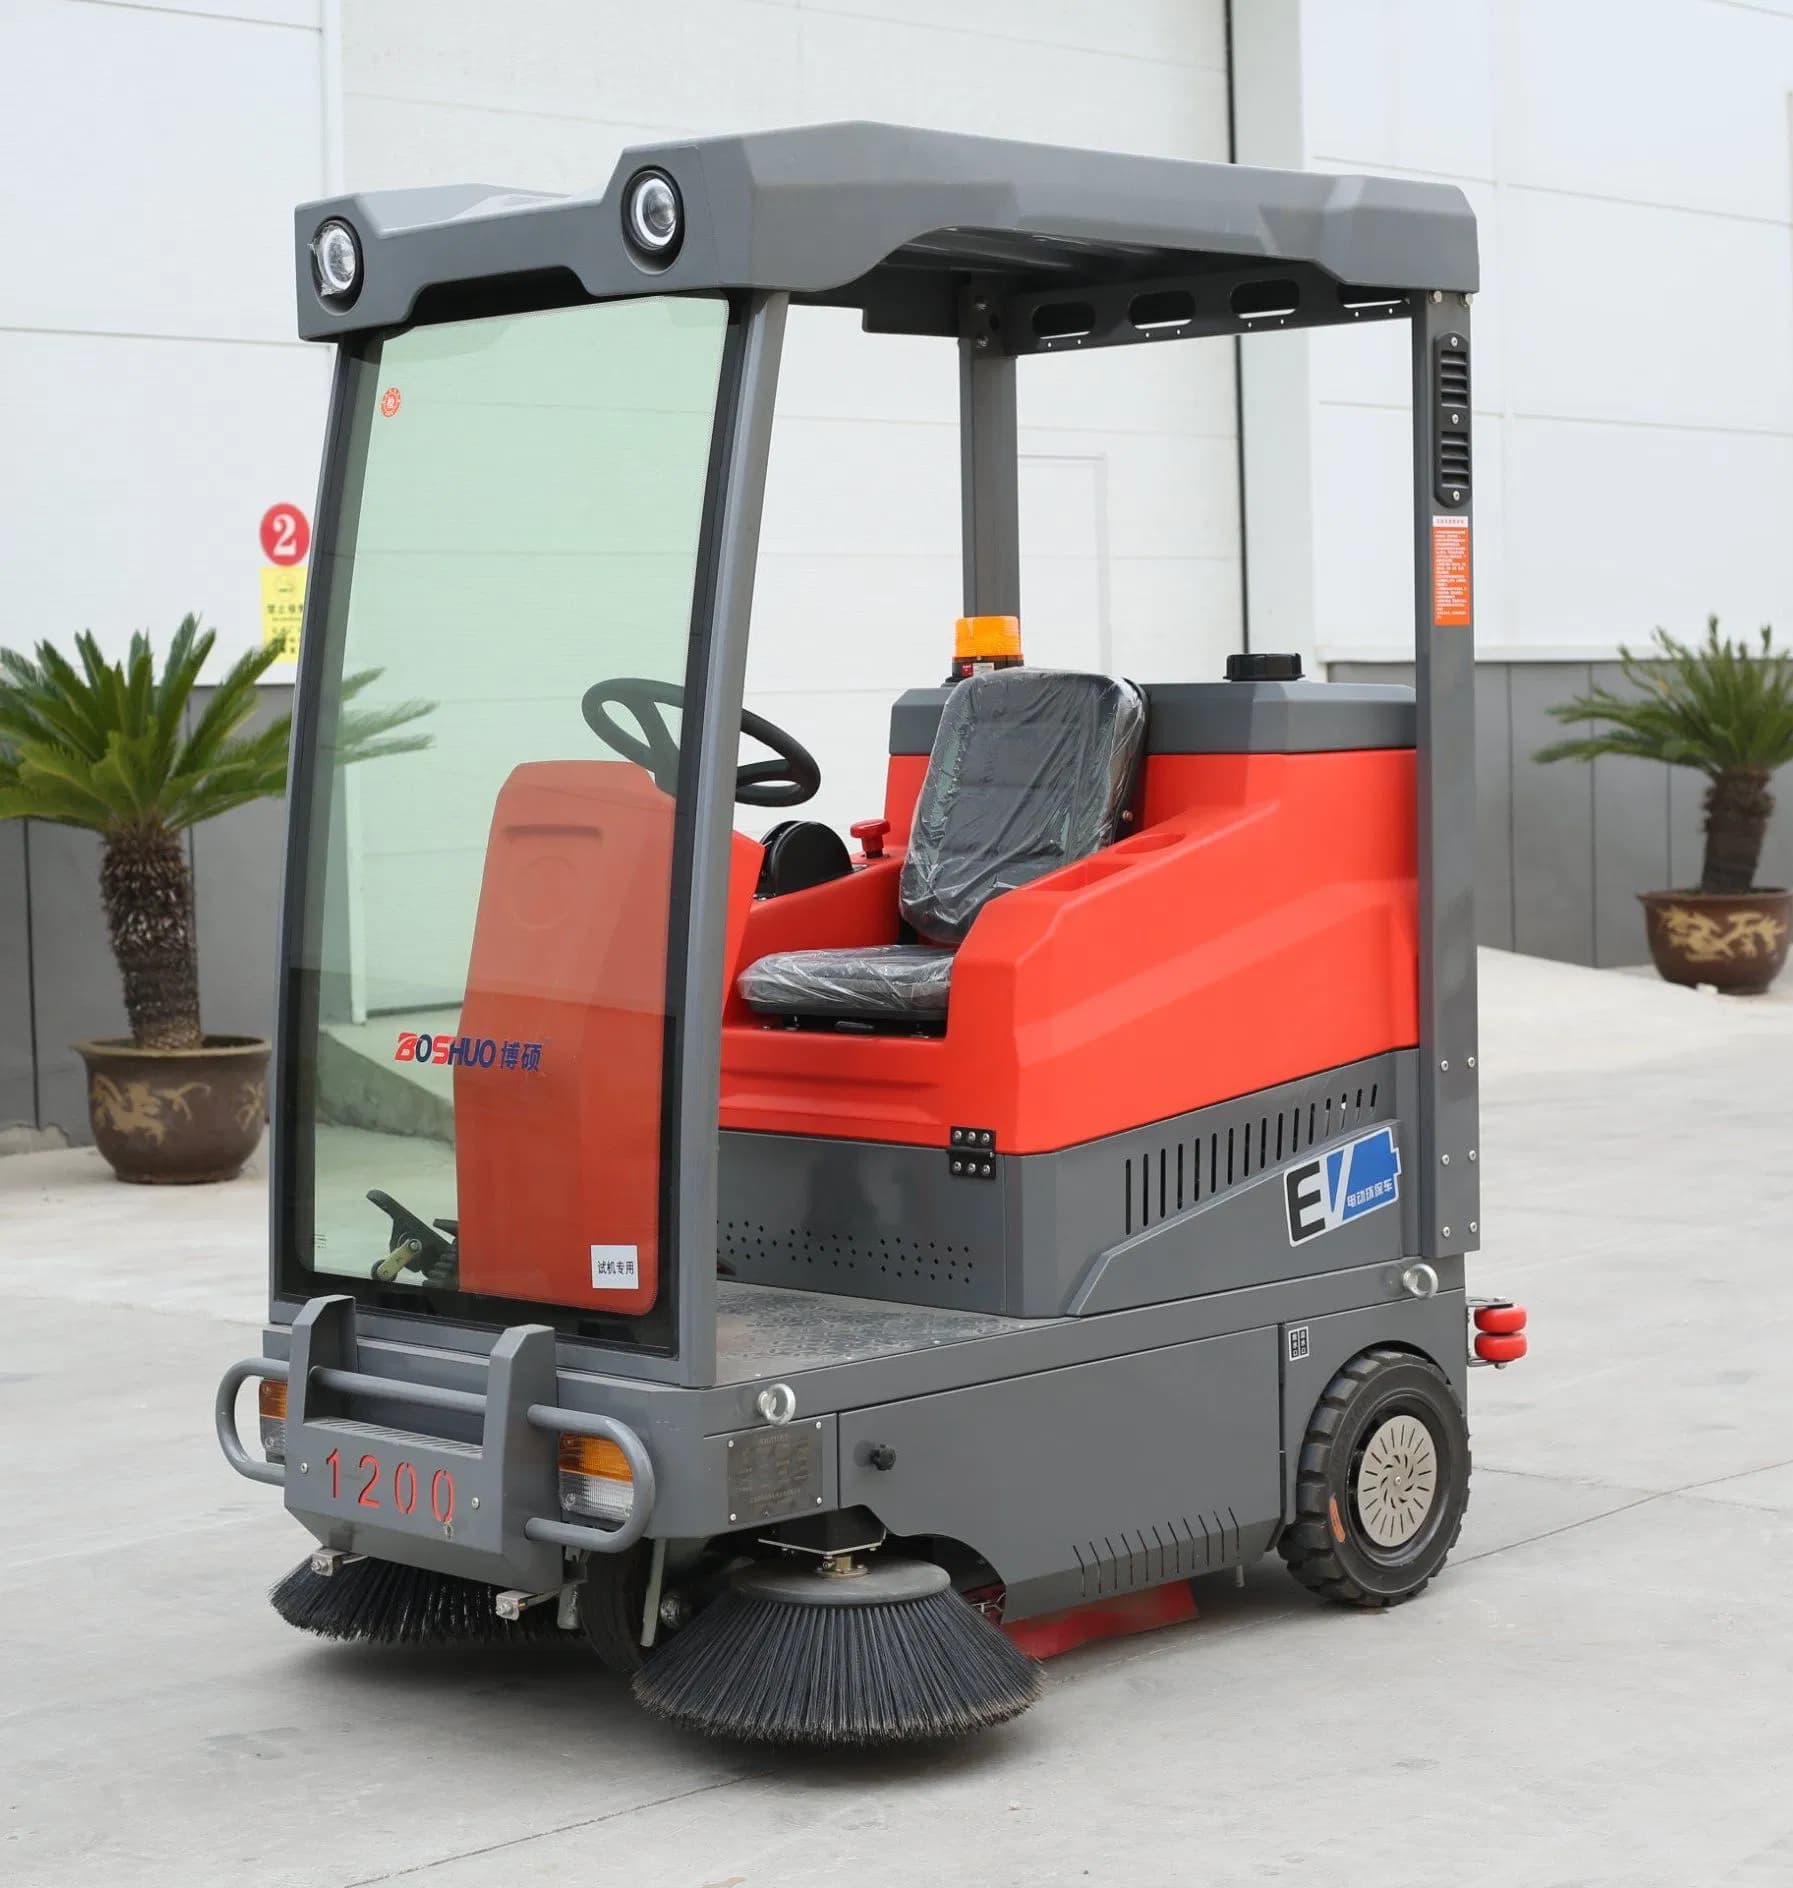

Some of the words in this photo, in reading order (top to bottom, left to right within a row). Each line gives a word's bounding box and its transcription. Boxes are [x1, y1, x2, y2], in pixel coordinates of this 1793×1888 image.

[272, 513, 297, 557] 2
[394, 1032, 496, 1068] BOSHUO
[500, 1040, 543, 1071] 博硕
[1346, 1178, 1393, 1208] 电动环保车
[597, 1260, 634, 1275] 试机专用
[325, 1447, 456, 1523] 1200
